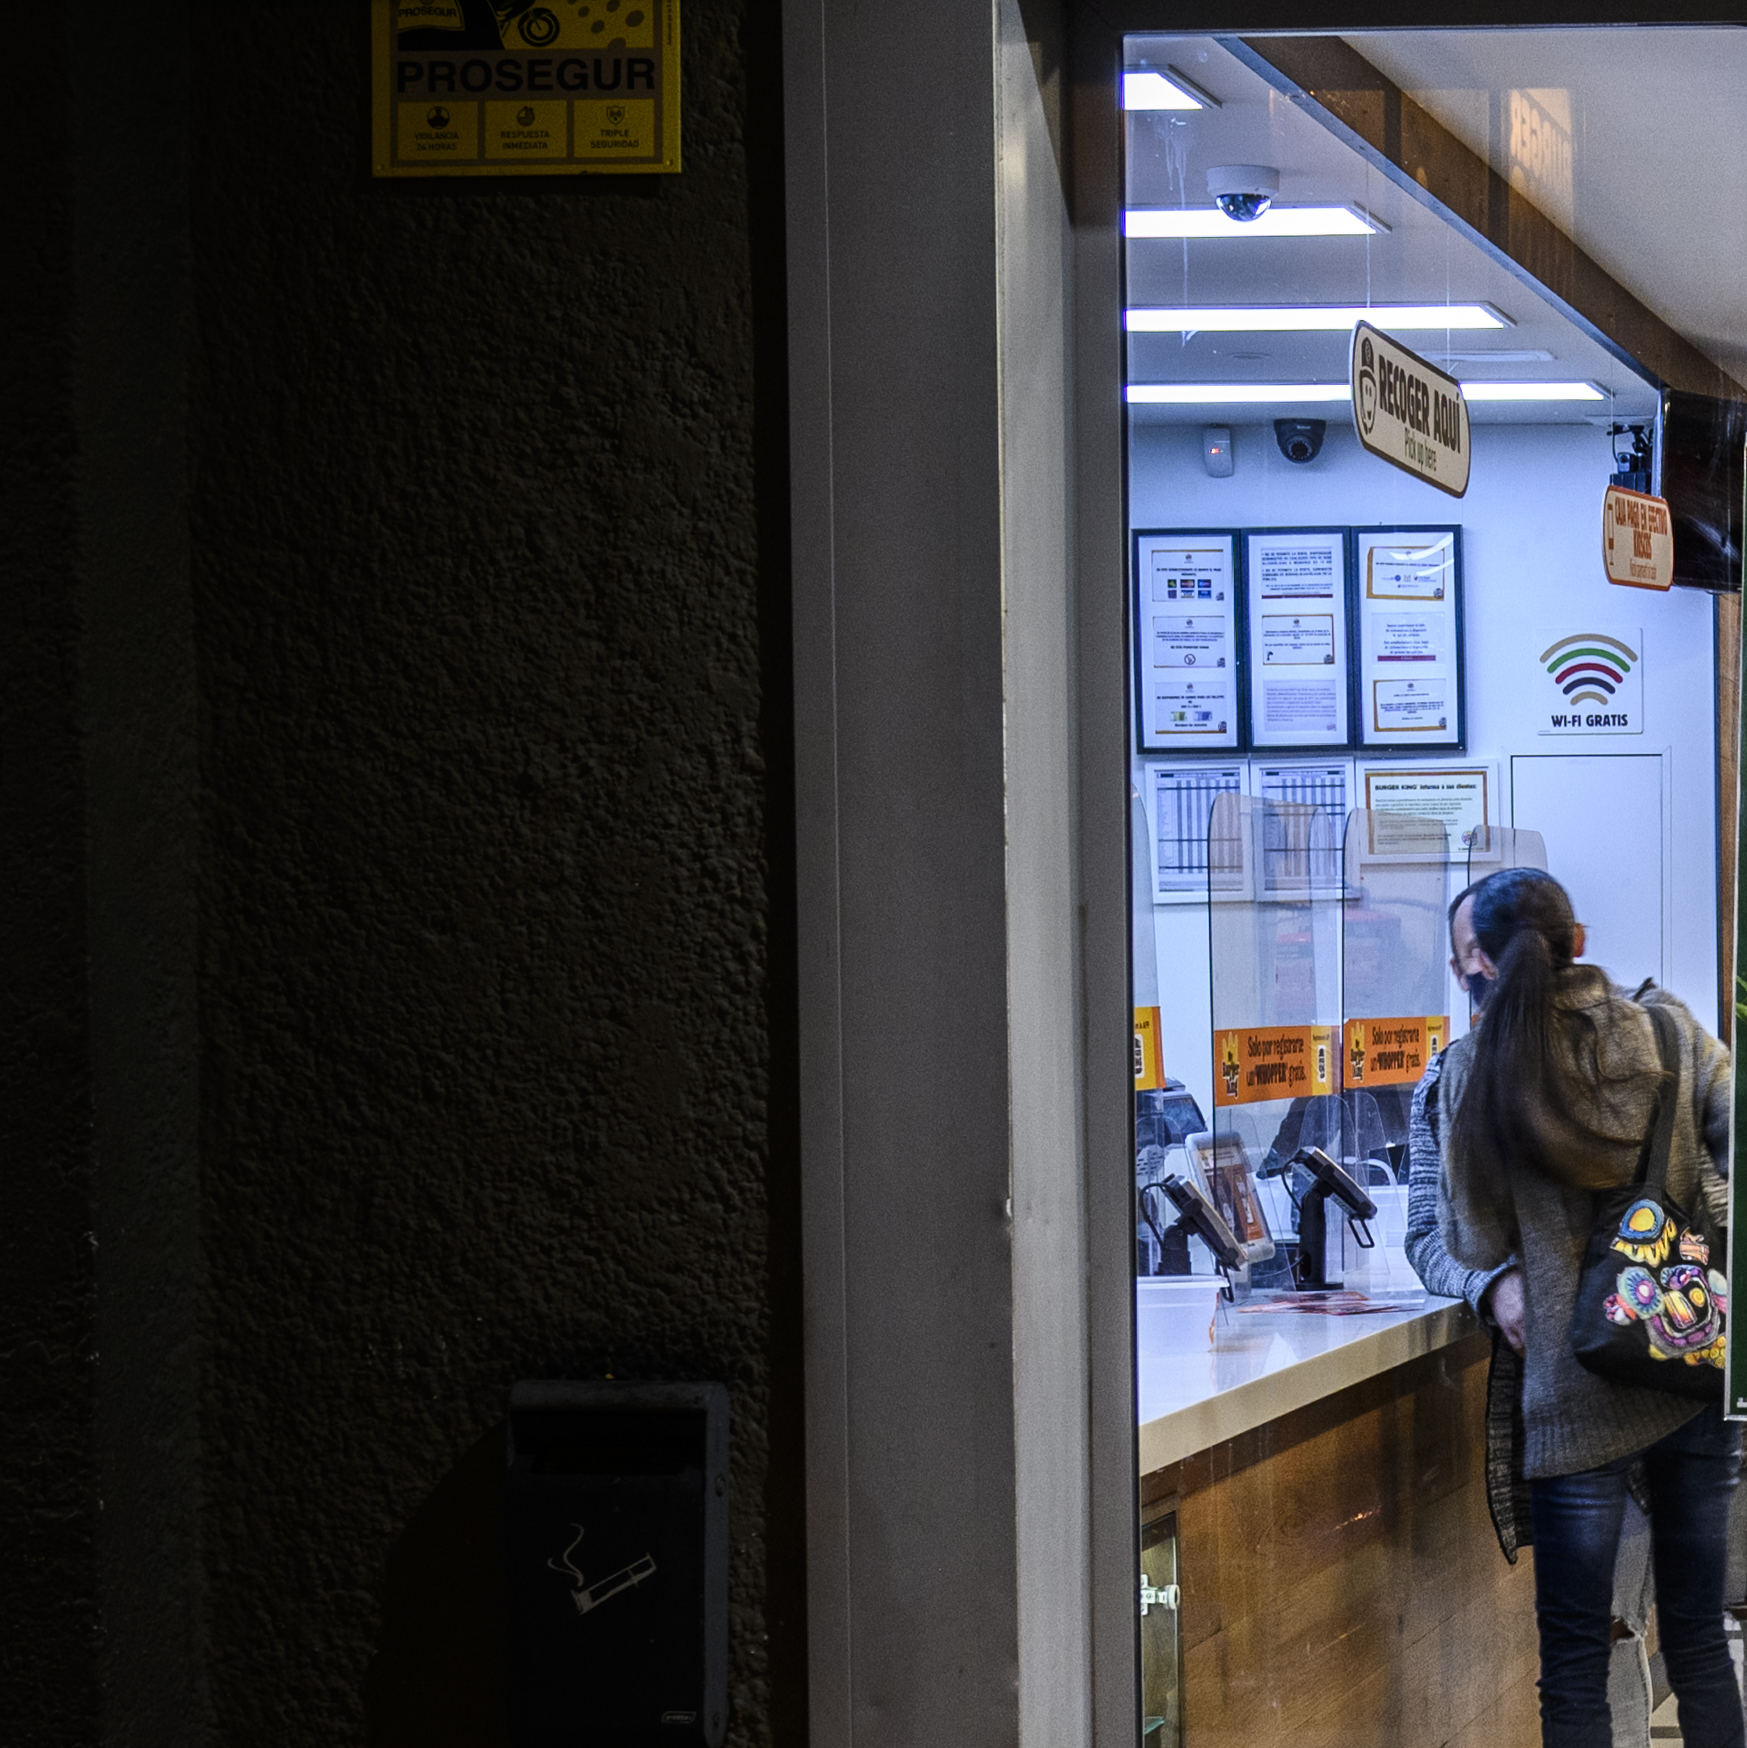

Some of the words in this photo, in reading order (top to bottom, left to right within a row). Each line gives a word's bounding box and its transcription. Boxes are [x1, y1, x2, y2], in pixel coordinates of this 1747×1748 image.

[399, 5, 457, 17] PROSEGUR
[397, 58, 655, 93] PROSEGUR
[414, 131, 460, 140] VIGILANCIA
[500, 130, 550, 139] RESPUESTA
[428, 142, 457, 151] HORAS
[502, 141, 548, 150] INMEDIATA
[590, 140, 639, 149] SEGURIDAD
[1379, 354, 1431, 437] RECOGER
[1433, 392, 1461, 454] AQUÍ
[1551, 715, 1581, 728] WI-FI
[1586, 714, 1628, 727] GRATIS
